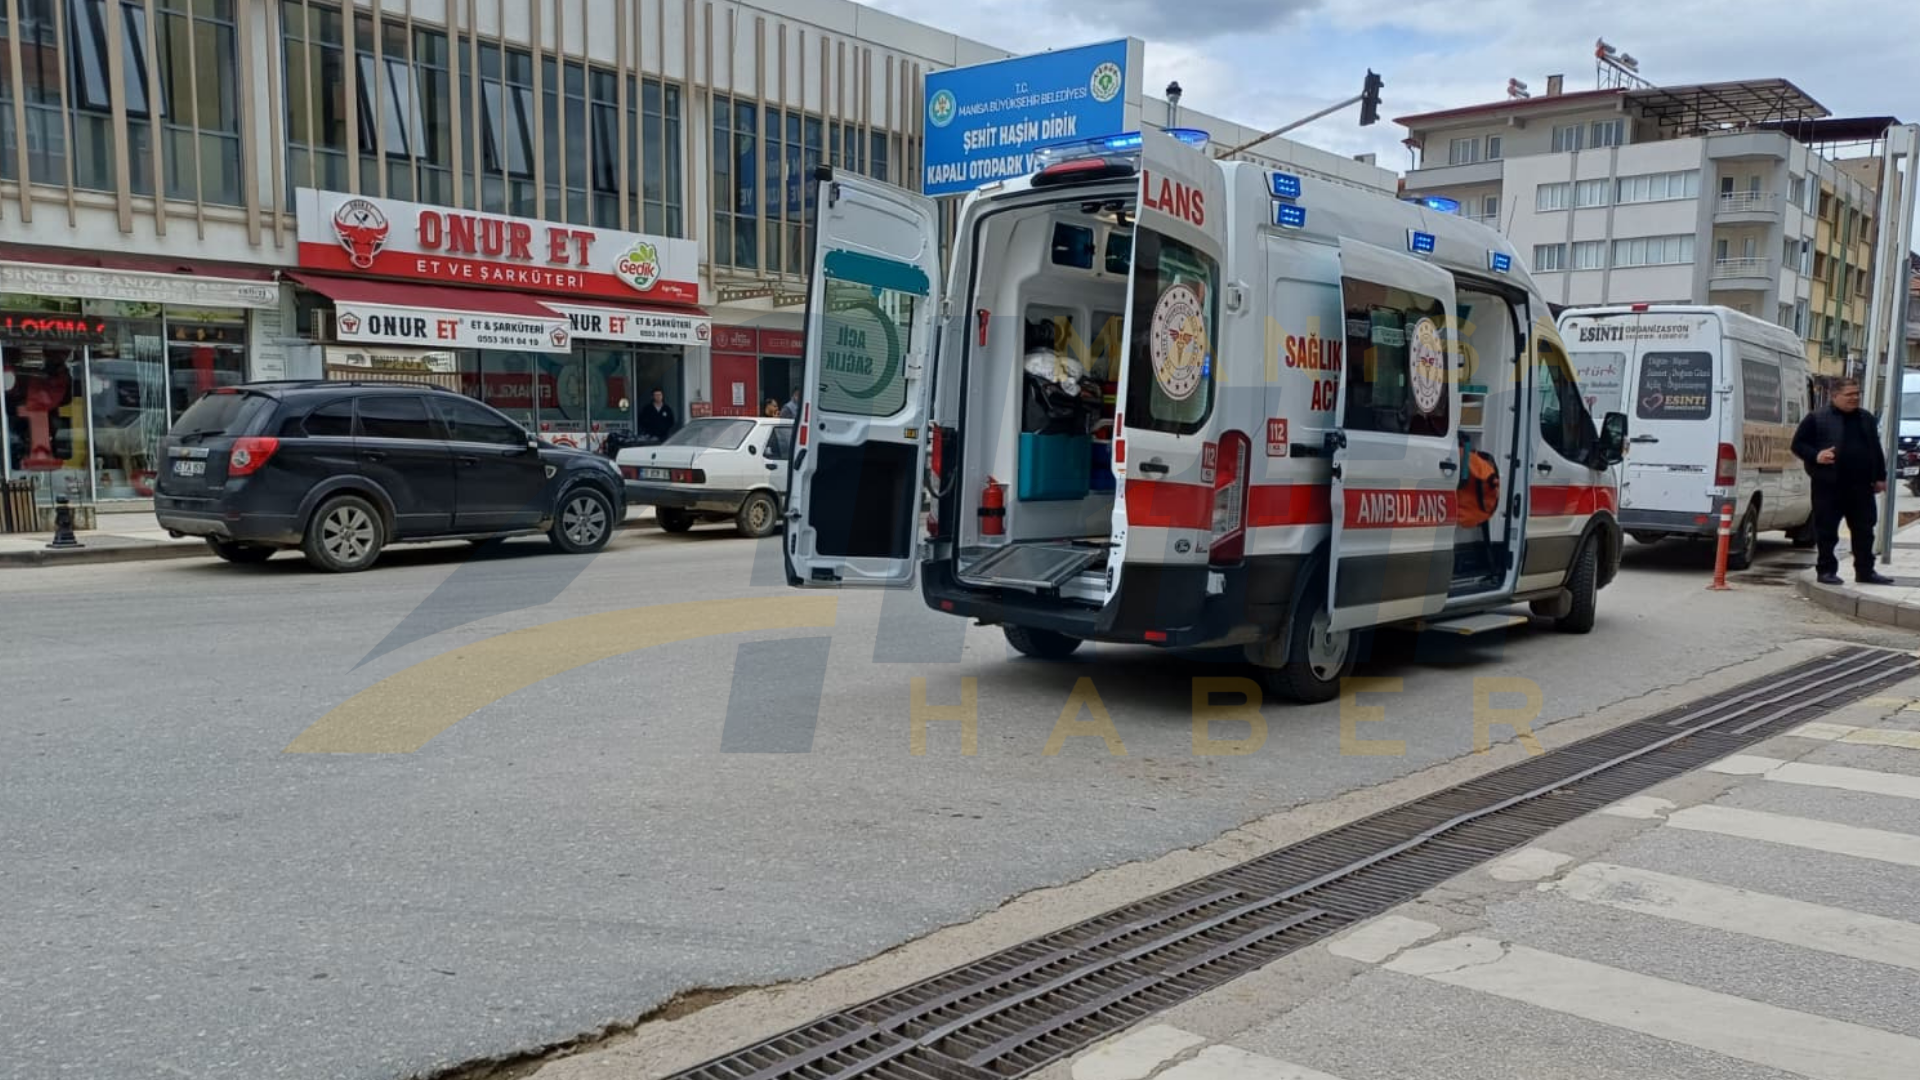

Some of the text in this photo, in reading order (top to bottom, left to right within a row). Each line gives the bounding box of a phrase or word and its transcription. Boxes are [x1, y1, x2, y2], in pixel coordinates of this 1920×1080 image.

[1015, 82, 1028, 94] T.C.
[959, 86, 1087, 116] MANİSA BÜYÜKŞEHİR BELEDİYESİ
[963, 111, 1076, 154] ŞEHİT HAŞİM DİRİK
[927, 162, 966, 184] KAPALI
[969, 156, 1023, 178] OTOPARK
[418, 210, 595, 266] ONUR ET
[417, 260, 583, 287] ET VE ŞARKÜTERİ
[620, 259, 655, 277] Gedik
[6, 317, 88, 339] LOKMA
[368, 315, 544, 340] ONUR ET ET & ŞARKÜTERİ
[568, 313, 691, 334] NUR ET ET & ŞARKÜTERİ
[1579, 322, 1624, 342] ESİNTİ
[1625, 323, 1689, 333] ORGANİZASYON
[477, 335, 498, 343] 0553
[1285, 332, 1342, 371] SAĞLIK
[1311, 374, 1339, 411] ACİ
[1665, 395, 1707, 405] ESİNTİ
[1270, 423, 1285, 440] 112
[1204, 446, 1216, 466] 112
[1356, 493, 1447, 525] AMBULANS
